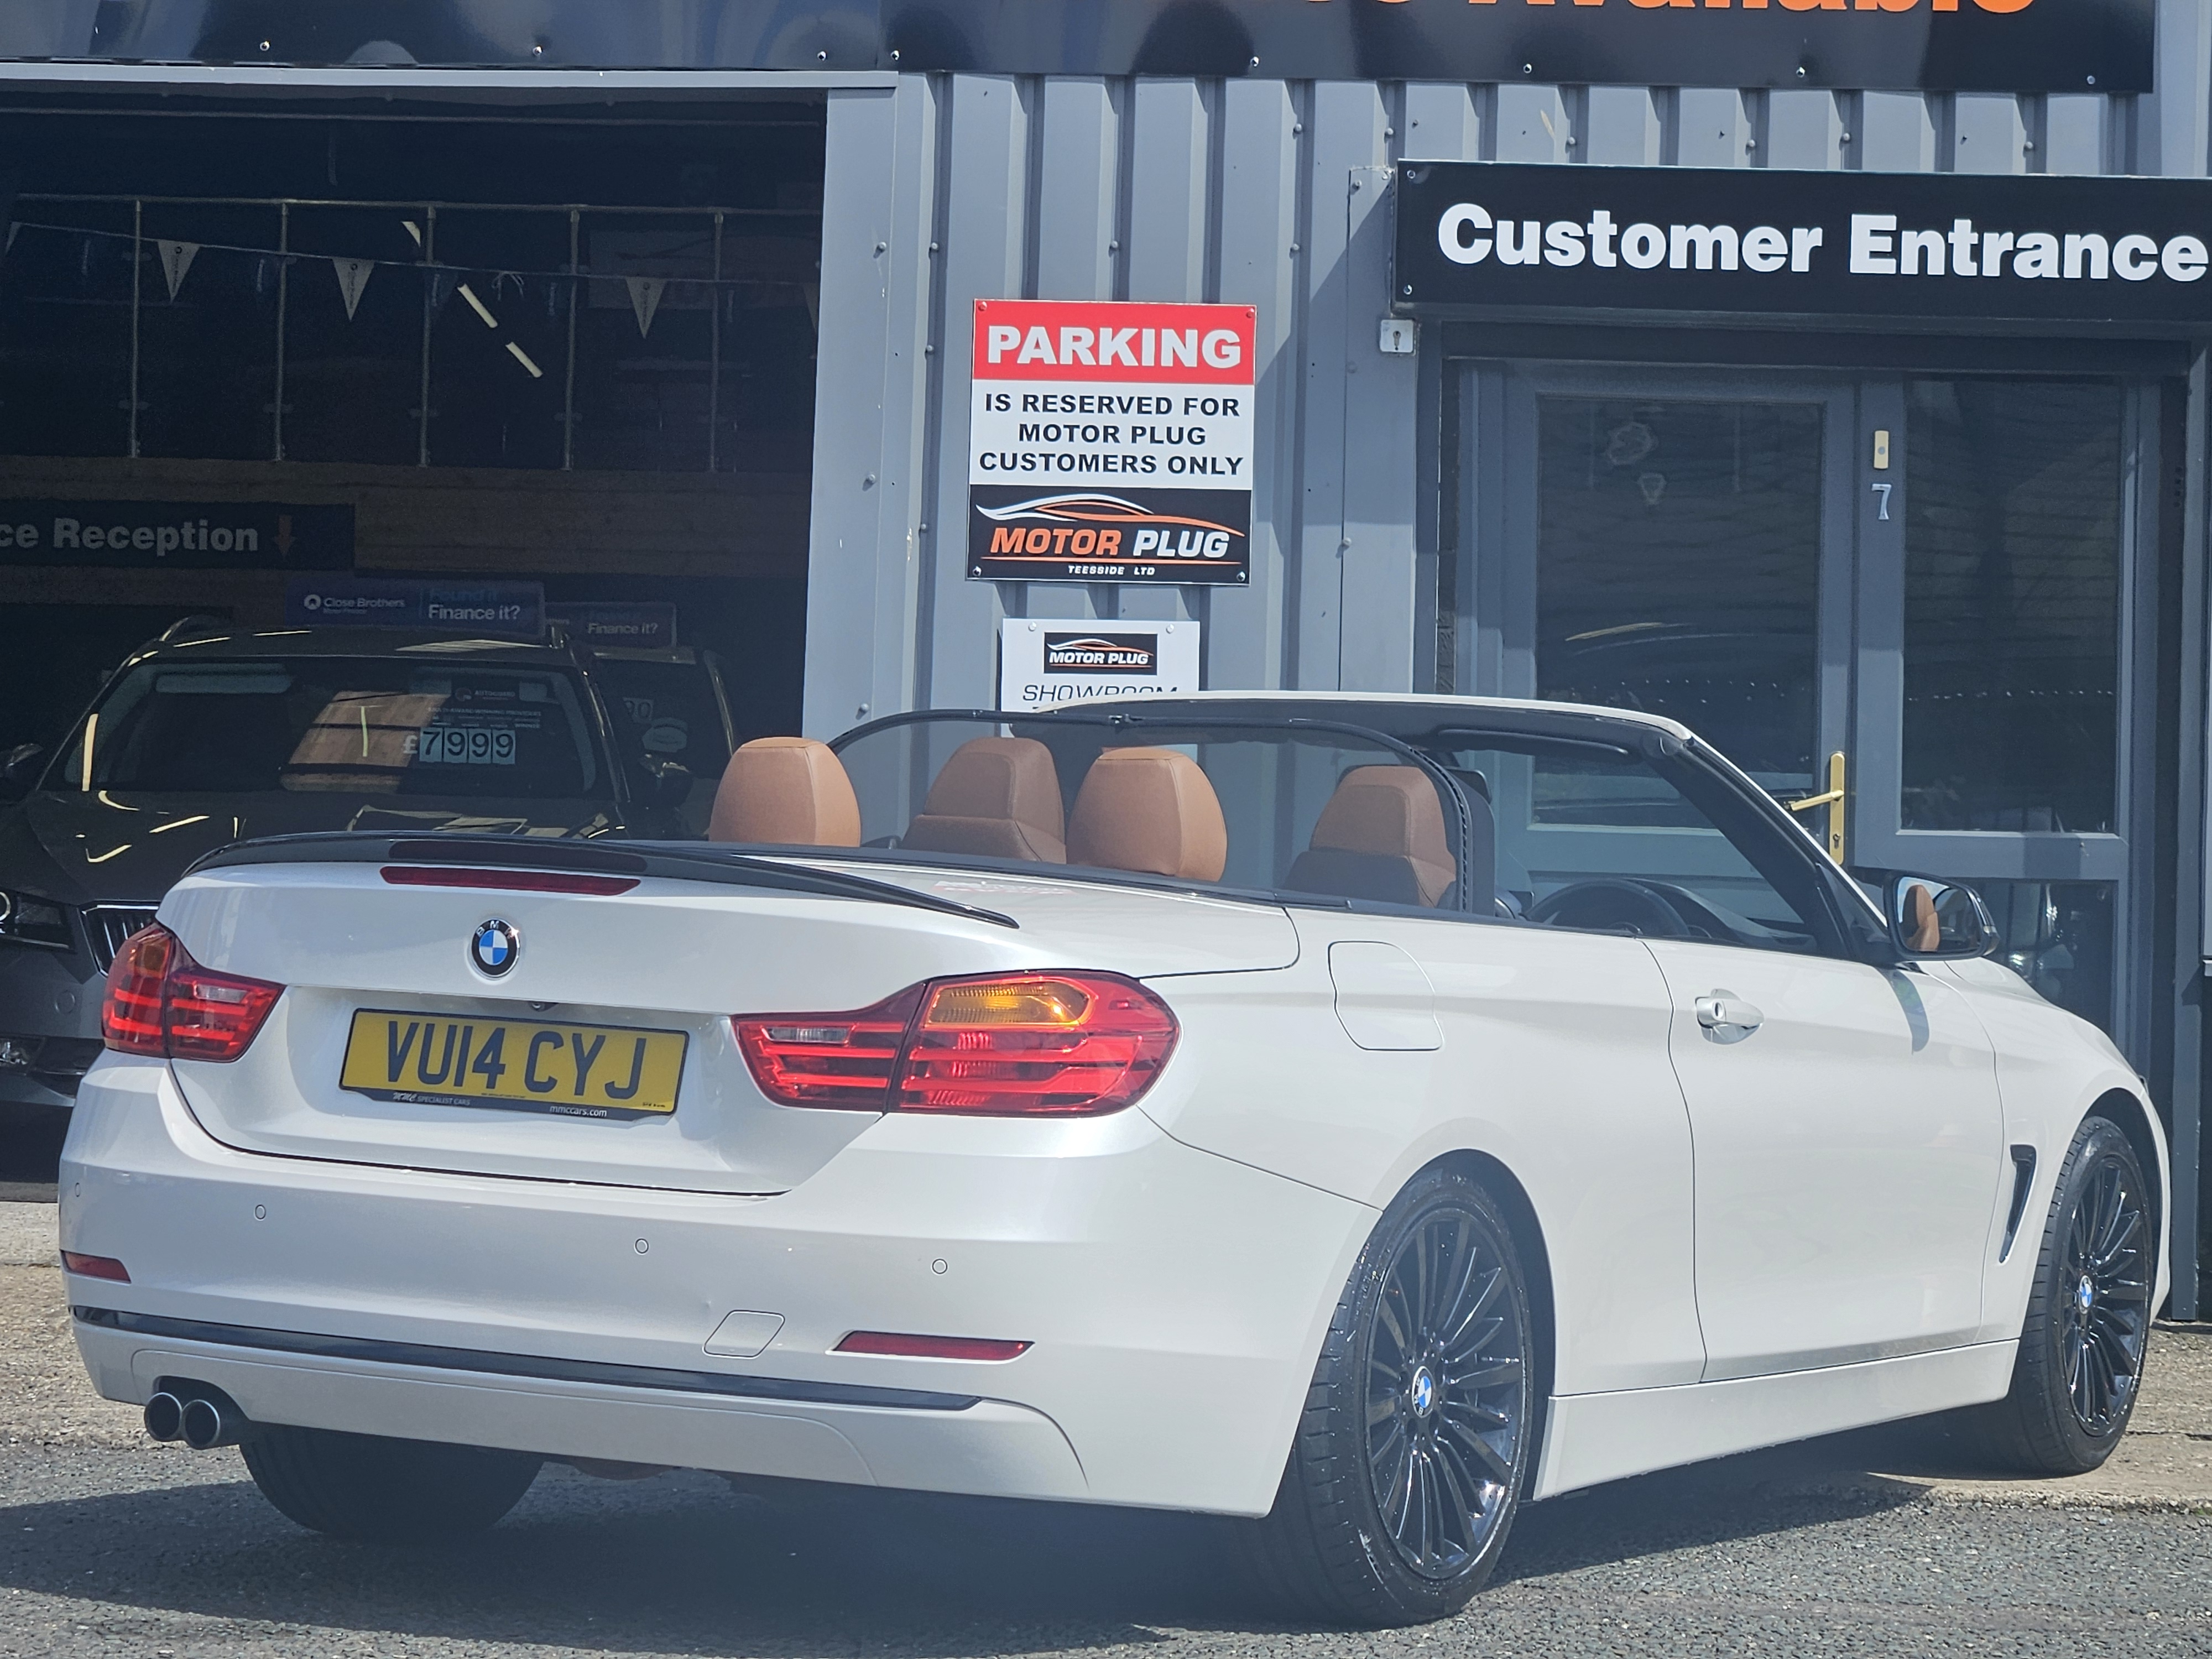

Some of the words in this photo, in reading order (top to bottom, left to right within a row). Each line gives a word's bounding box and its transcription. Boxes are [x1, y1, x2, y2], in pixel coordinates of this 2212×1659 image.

[1438, 203, 1823, 272] Customer
[1850, 214, 2209, 281] Entrance
[987, 325, 1241, 368] PARKING
[985, 393, 1011, 411] IS
[1022, 394, 1172, 415] RESERVED
[1183, 398, 1240, 417] FOR
[1019, 423, 1120, 443] MOTOR
[1131, 426, 1206, 445] PLUG
[979, 452, 1157, 474] CUSTOMERS
[1167, 456, 1244, 475] ONLY
[1871, 483, 1892, 520] 7
[53, 518, 258, 556] Reception
[990, 528, 1122, 556] MOTOR
[1133, 529, 1230, 557] PLUG
[1068, 565, 1125, 575] TEESSIDE
[1134, 566, 1155, 576] LTD
[323, 597, 354, 607] Close
[356, 598, 406, 608] Brothers
[428, 604, 495, 620] Finance
[499, 604, 521, 620] it?
[587, 623, 639, 634] Finance
[641, 622, 659, 634] it?
[1049, 652, 1105, 664] MOTOR
[1108, 653, 1149, 664] PLUG
[403, 731, 514, 758] £7999
[388, 1020, 506, 1090] VU14
[524, 1031, 647, 1100] CYJ
[417, 1095, 453, 1104] SPECIALIST
[550, 1106, 607, 1117] mmccars.com
